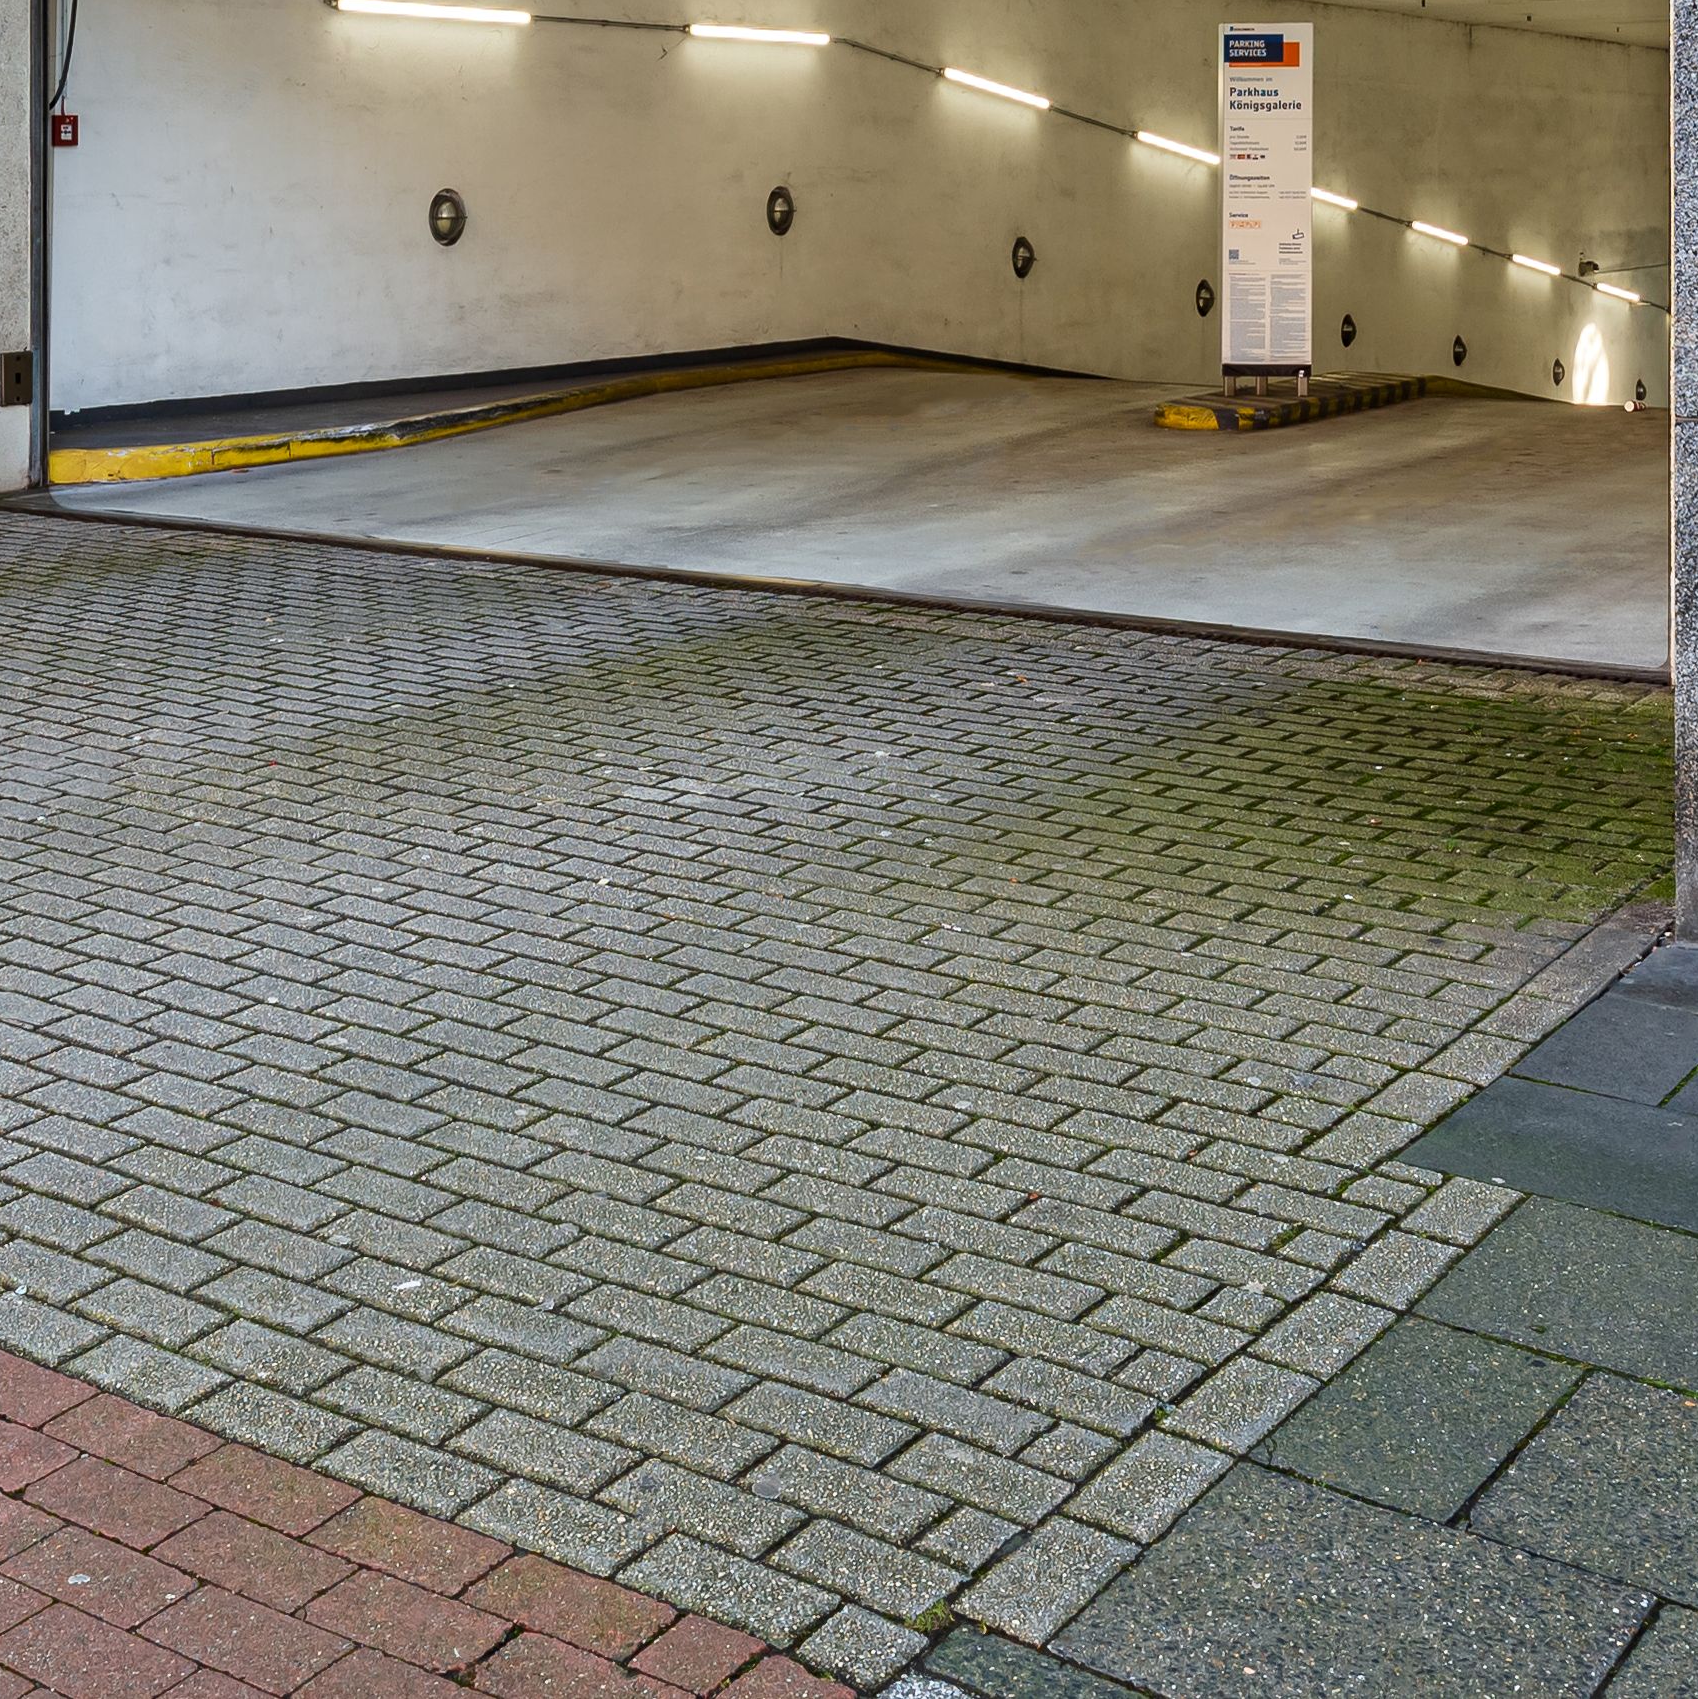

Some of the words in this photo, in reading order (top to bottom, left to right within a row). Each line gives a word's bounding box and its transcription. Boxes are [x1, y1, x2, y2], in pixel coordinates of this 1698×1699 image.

[1229, 40, 1266, 48] PARKING
[1229, 49, 1267, 57] SERVICES
[1229, 86, 1279, 97] Parkhaus
[1229, 100, 1302, 112] Königsgalerie
